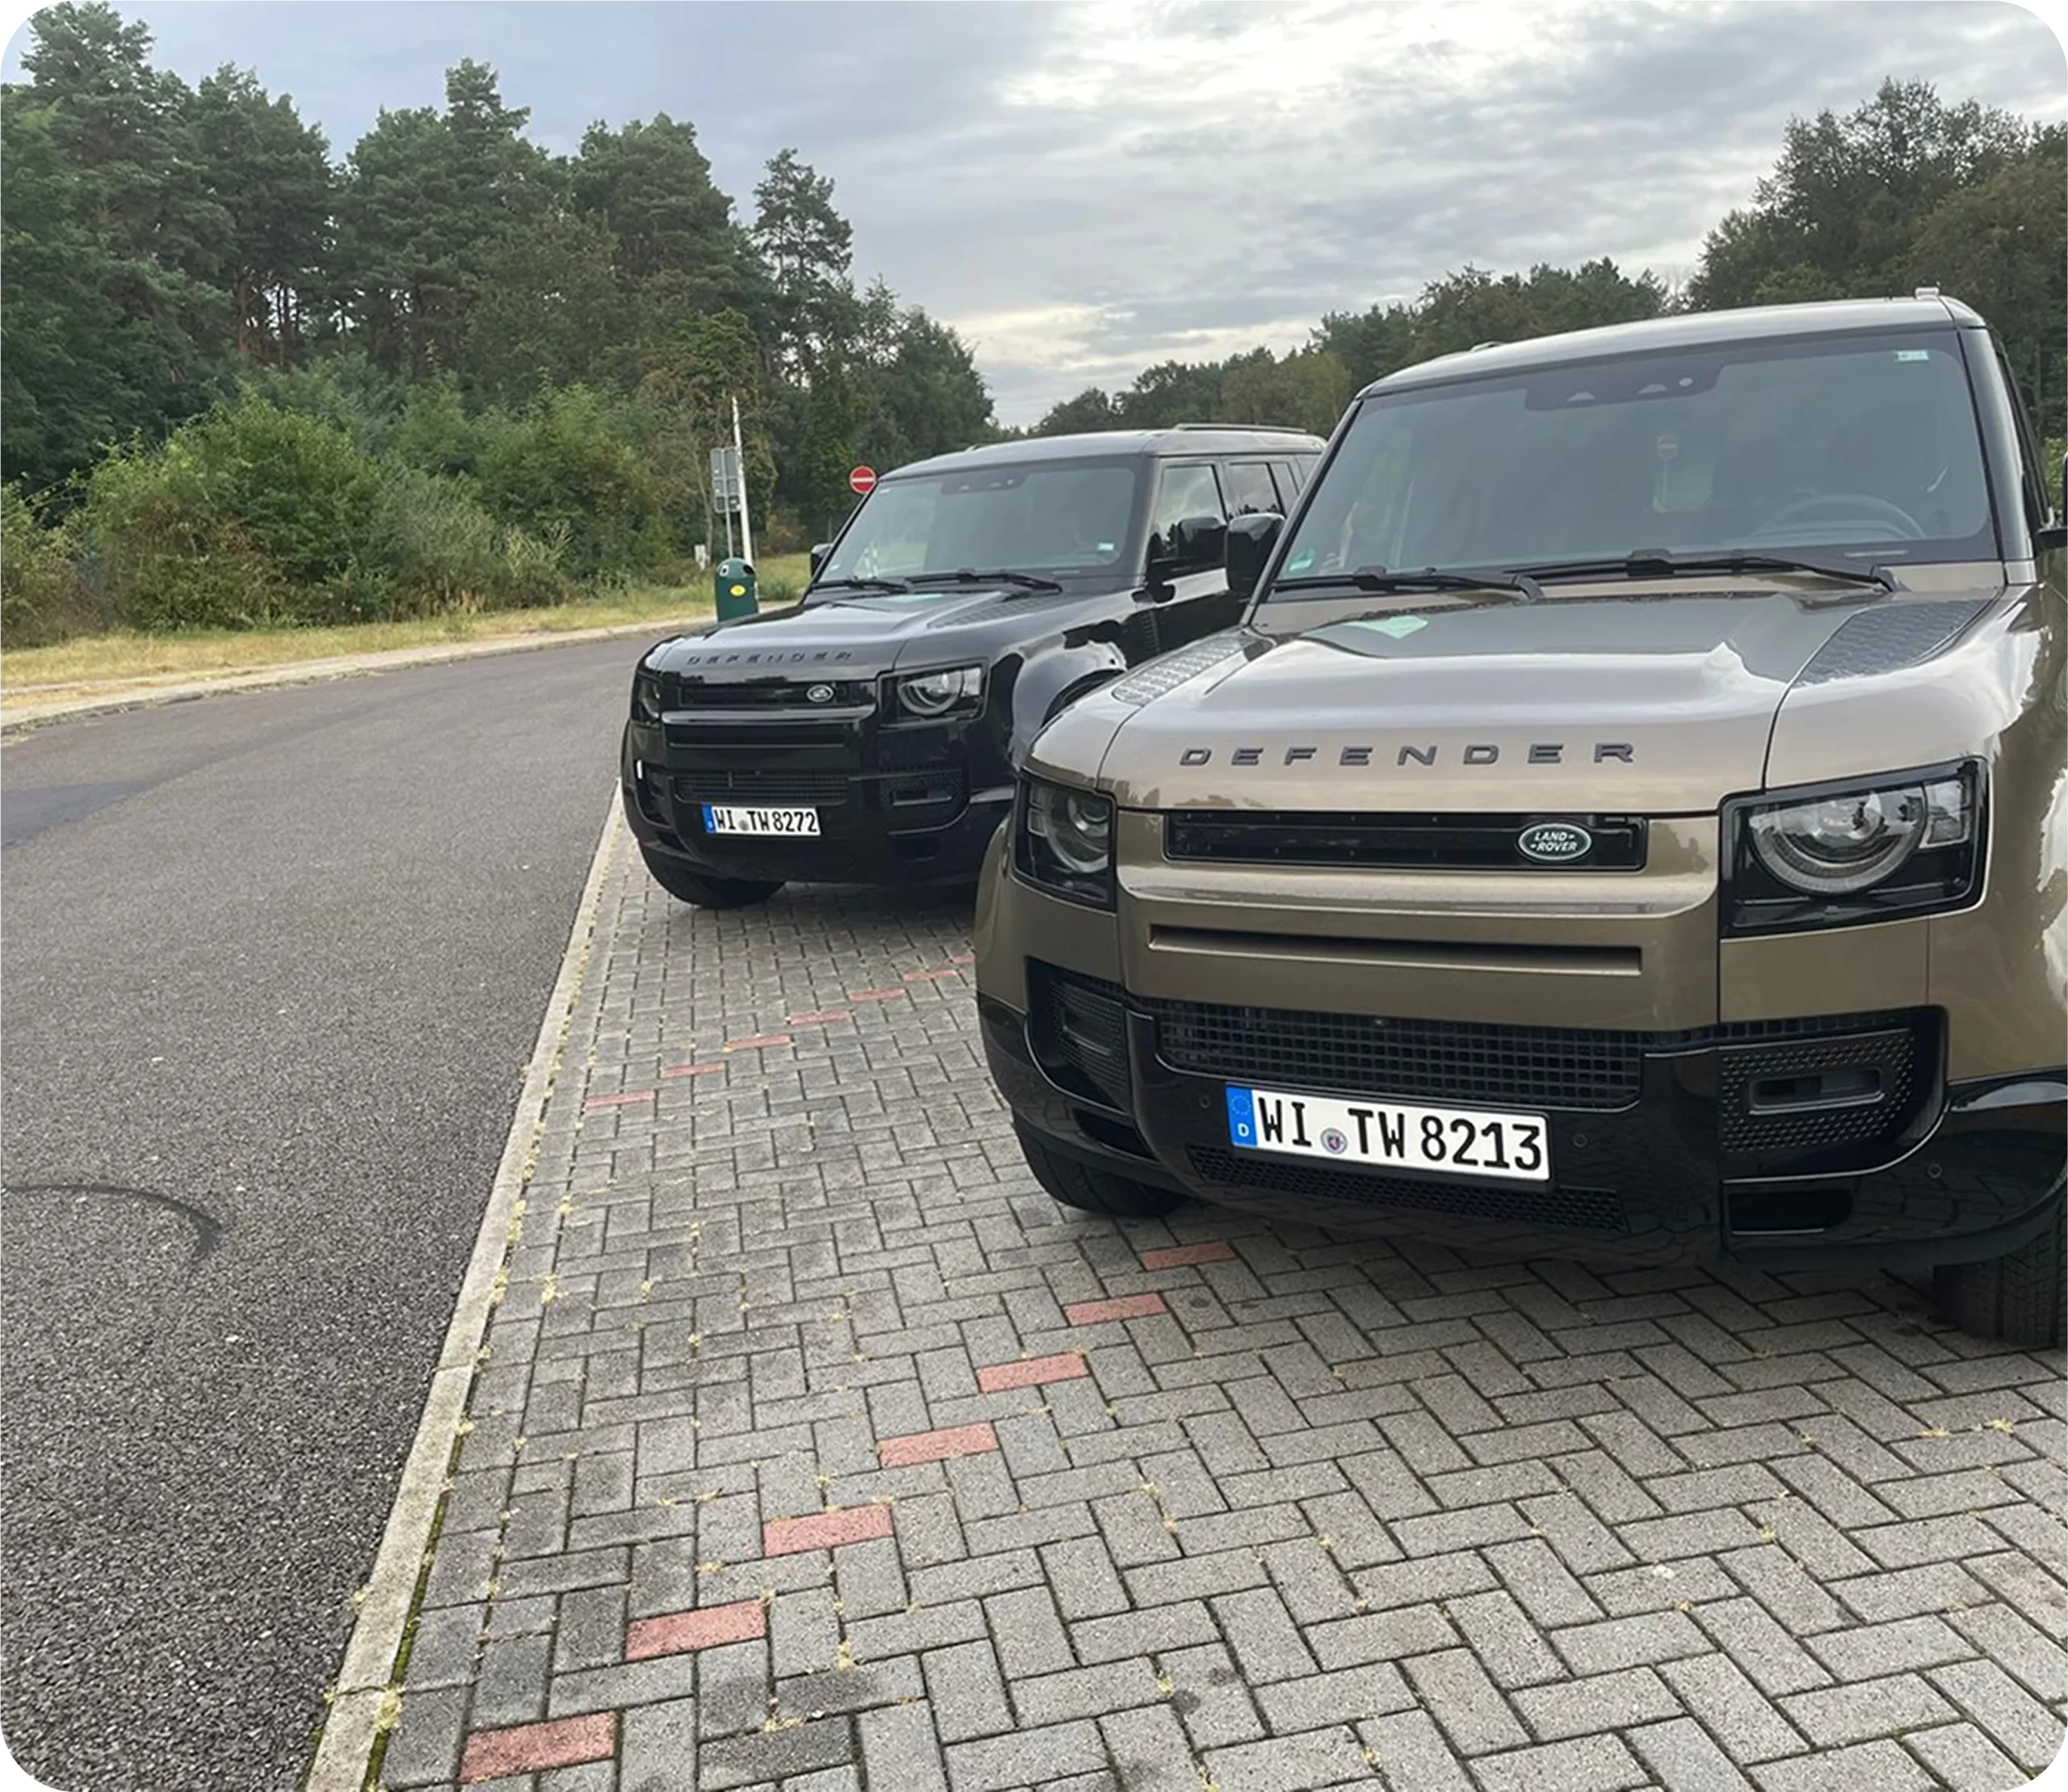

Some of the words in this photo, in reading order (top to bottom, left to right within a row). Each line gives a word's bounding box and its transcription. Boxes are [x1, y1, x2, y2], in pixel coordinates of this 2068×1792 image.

[1179, 742, 1635, 767] DEFENDER
[714, 809, 736, 830] WI
[772, 810, 818, 832] 8272
[1534, 831, 1567, 841] LAND
[1536, 841, 1578, 852] ROVER
[1258, 1097, 1312, 1147] WI
[1348, 1108, 1406, 1159] TW
[1420, 1115, 1541, 1172] 8213
